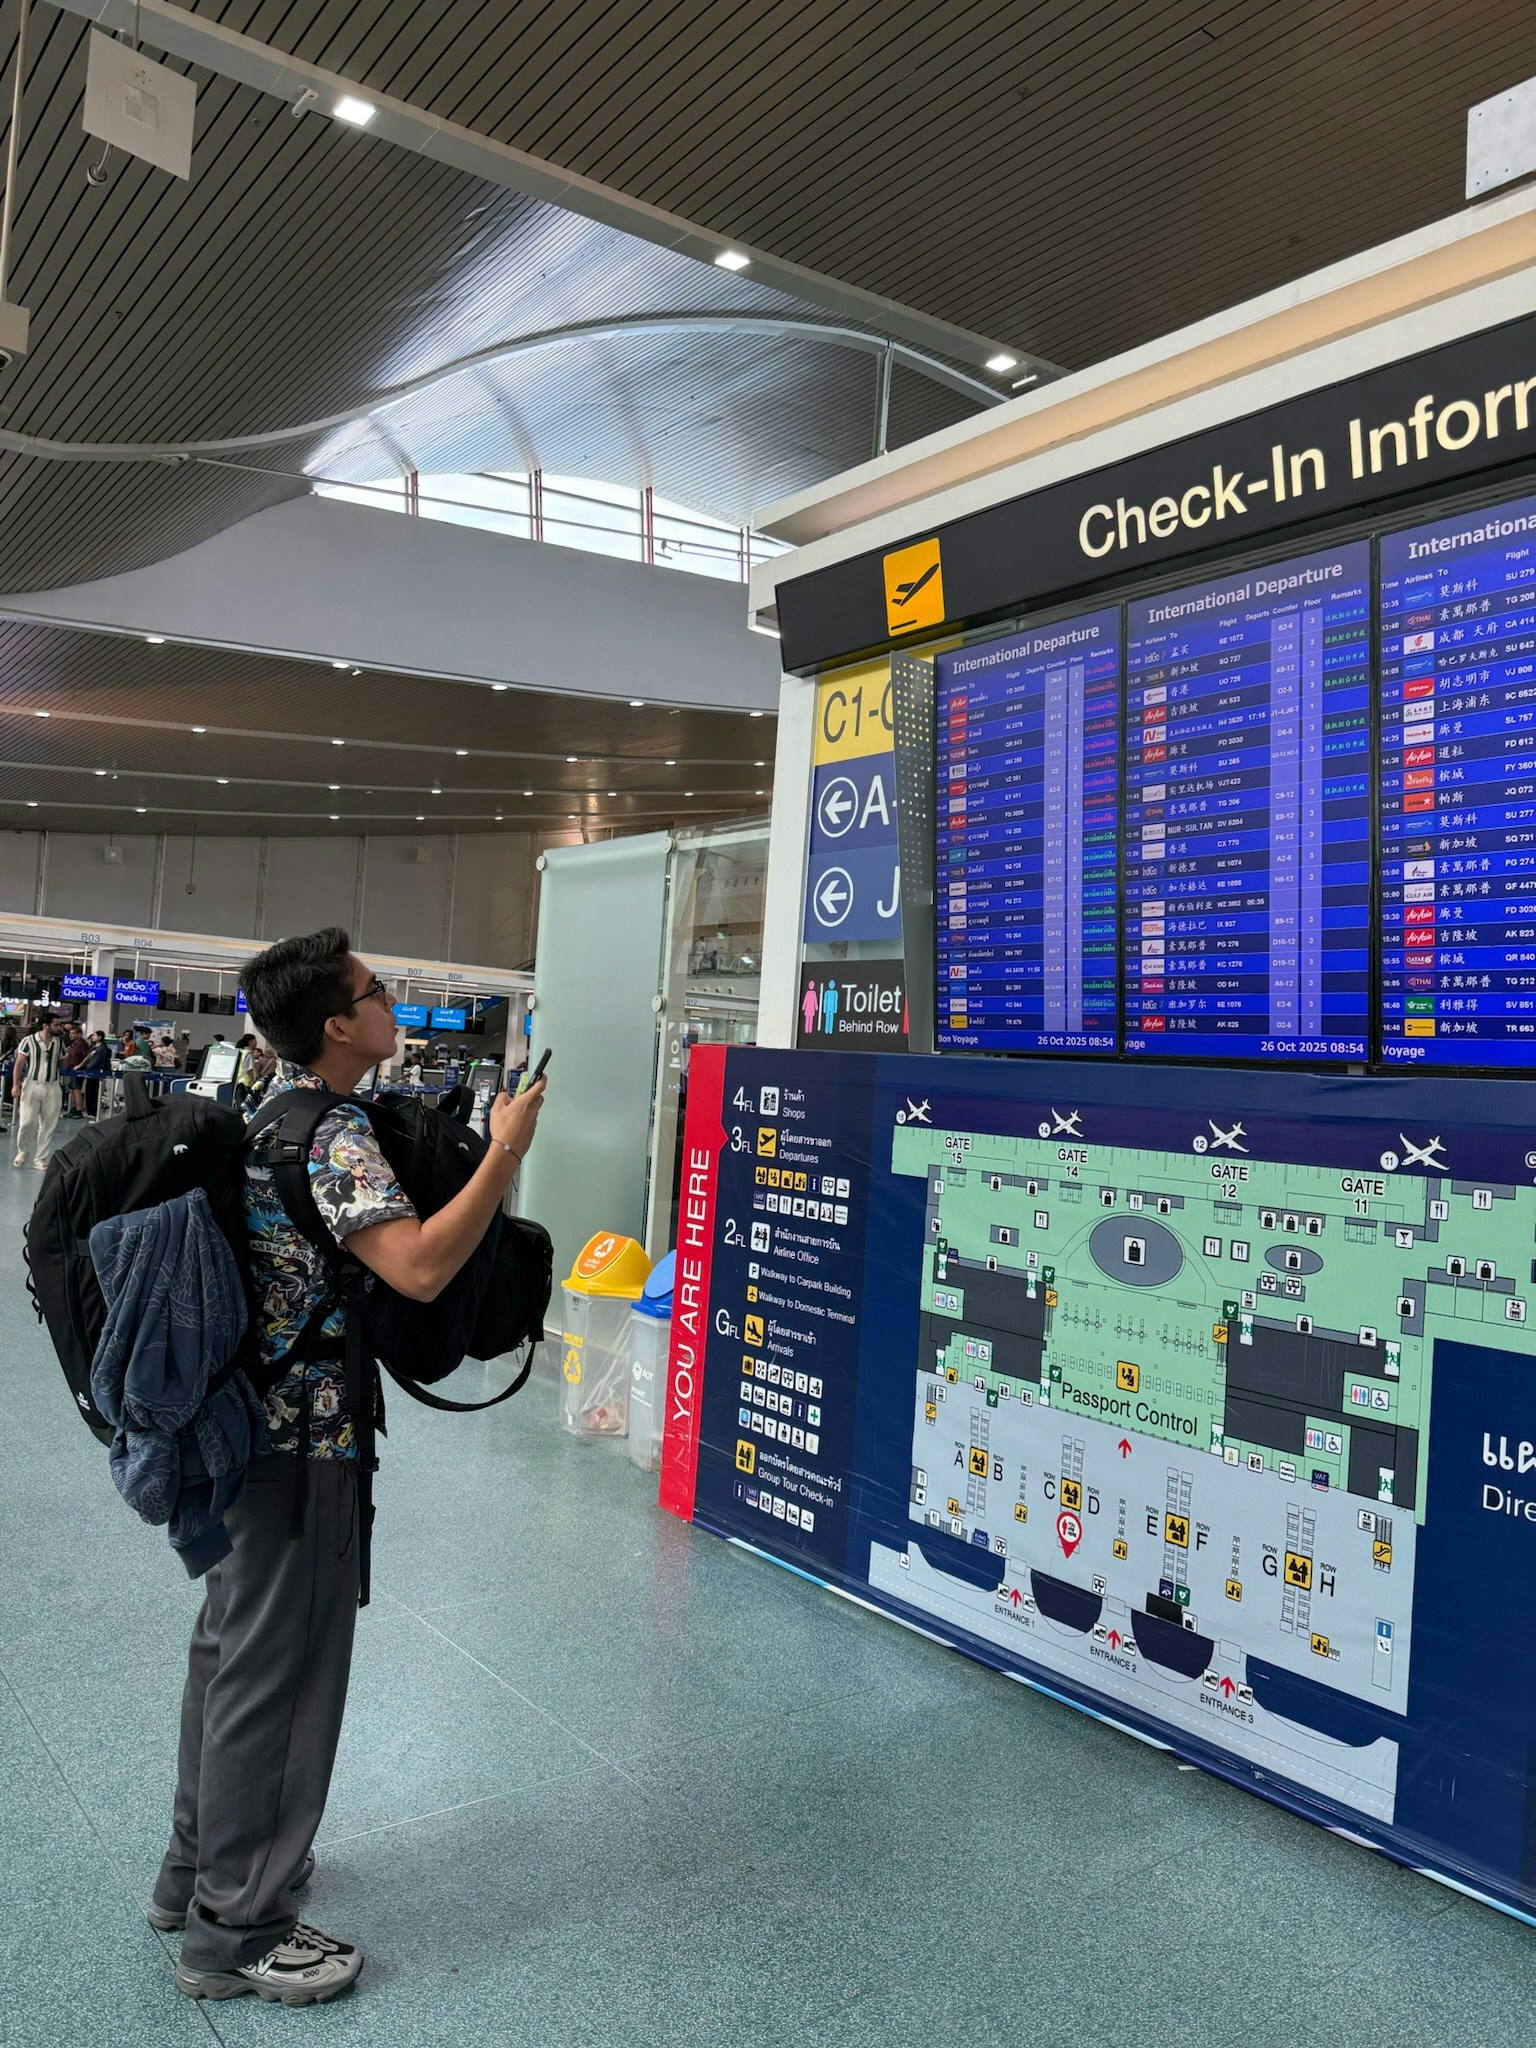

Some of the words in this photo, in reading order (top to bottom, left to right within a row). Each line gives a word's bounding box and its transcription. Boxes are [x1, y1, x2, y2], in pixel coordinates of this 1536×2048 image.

[1078, 444, 1327, 559] Check-In
[1381, 580, 1399, 590] Time
[1404, 573, 1433, 585] Airlines
[1437, 568, 1448, 577] To
[1505, 548, 1530, 561] Flight
[1505, 572, 1518, 581] SU
[1148, 584, 1250, 624] International
[1256, 562, 1343, 597] Departure
[1439, 578, 1478, 598] 莫斯科
[1145, 634, 1166, 646] Airlines
[1219, 617, 1237, 628] Flight
[1246, 610, 1270, 622] Departs
[1272, 603, 1298, 615] Counter
[1304, 596, 1322, 608] Floor
[1331, 588, 1362, 602] Remarks
[1505, 620, 1517, 629] CA
[1519, 616, 1535, 626] 414
[1439, 629, 1465, 644] 成都
[1473, 621, 1498, 636] 天府
[953, 642, 1030, 675] International
[1033, 626, 1100, 653] Departure
[1170, 662, 1199, 677] 新加坡
[1439, 670, 1490, 689] 胡志明市
[1170, 702, 1199, 717] 吉隆坡
[1439, 694, 1490, 713] 上海浦东
[1505, 739, 1517, 748] FD
[1518, 737, 1534, 746] 612
[1505, 811, 1517, 819] SU
[1167, 821, 1213, 835] NUR-SULTAN
[1439, 836, 1477, 850] 新加坡
[81, 933, 101, 943] B03
[1439, 929, 1477, 942] 吉隆坡
[1505, 930, 1518, 938] AK
[134, 938, 152, 948] B04
[408, 968, 423, 976] B07
[64, 975, 95, 987] IndiGo
[116, 980, 146, 992] IndiGo
[1505, 977, 1518, 985] TG
[1519, 977, 1535, 985] 212
[63, 988, 96, 999] Check-in
[115, 992, 147, 1003] Check-in
[841, 983, 901, 1014] Toilet
[1440, 998, 1478, 1011] 利雅得
[1519, 1001, 1534, 1009] 851
[839, 1019, 872, 1034] Behind
[875, 1020, 899, 1034] Row
[952, 1035, 979, 1044] Voyage
[1037, 1036, 1048, 1046] 26
[1049, 1037, 1064, 1046] Oct
[1066, 1037, 1087, 1047] 2025
[1089, 1037, 1114, 1047] 08:54
[1261, 1041, 1276, 1051] 26
[1277, 1041, 1296, 1052] Oct
[1299, 1042, 1328, 1053] 2025
[1330, 1042, 1364, 1054] 08:54
[1381, 1044, 1425, 1058] Voyage
[783, 1087, 805, 1102] ร้านค้า
[782, 1107, 806, 1120] Shops
[780, 1128, 832, 1148] ผู้โดยสารขาออก
[945, 1137, 971, 1150] GATE
[779, 1148, 819, 1164] Departures
[951, 1153, 962, 1164] 15
[1057, 1149, 1087, 1163] GATE
[1065, 1166, 1078, 1178] 14
[1211, 1164, 1248, 1181] GATE
[1220, 1184, 1237, 1197] 12
[1341, 1178, 1384, 1196] GATE
[686, 1147, 710, 1247] HERE
[1354, 1199, 1367, 1213] 11
[774, 1226, 841, 1251] สำนักงานสายการบิน
[773, 1245, 796, 1260] Airline
[797, 1249, 819, 1265] Office
[761, 1266, 787, 1283] Walkway
[788, 1273, 796, 1283] to
[796, 1276, 823, 1291] Carpark
[824, 1282, 852, 1299] Building
[679, 1260, 702, 1329] ARE
[758, 1290, 785, 1308] Walkway
[787, 1298, 794, 1308] to
[795, 1300, 825, 1317] Domestic
[826, 1308, 856, 1325] Terminal
[767, 1320, 816, 1345] ผู้โดยสารขาเข้า
[767, 1340, 794, 1357] Arrivals
[672, 1343, 696, 1422] YOU
[1062, 1383, 1131, 1417] Passport
[1136, 1404, 1198, 1436] Control
[954, 1441, 965, 1449] ROW
[953, 1450, 964, 1469] A
[993, 1454, 1004, 1462] ROW
[993, 1464, 1003, 1481] B
[1044, 1471, 1056, 1481] ROW
[758, 1466, 781, 1487] Group
[782, 1474, 798, 1492] Tour
[799, 1484, 834, 1508] Check-in
[1044, 1481, 1056, 1500] C
[1087, 1486, 1100, 1496] ROW
[1088, 1497, 1100, 1514] D
[1146, 1505, 1159, 1515] ROW
[1146, 1516, 1158, 1536] E
[1196, 1522, 1210, 1532] ROW
[1196, 1532, 1208, 1551] F
[1262, 1543, 1278, 1554] ROW
[1262, 1555, 1278, 1577] G
[1320, 1562, 1337, 1573] ROW
[1320, 1575, 1335, 1597] H
[994, 1604, 1030, 1627] ENTRANCE
[1031, 1620, 1035, 1628] 1
[1090, 1645, 1129, 1671] ENTRANCE
[1131, 1664, 1137, 1673] 2
[1200, 1693, 1246, 1720] ENTRANCE
[1247, 1714, 1254, 1724] 3
[302, 1968, 320, 1979] 1000
